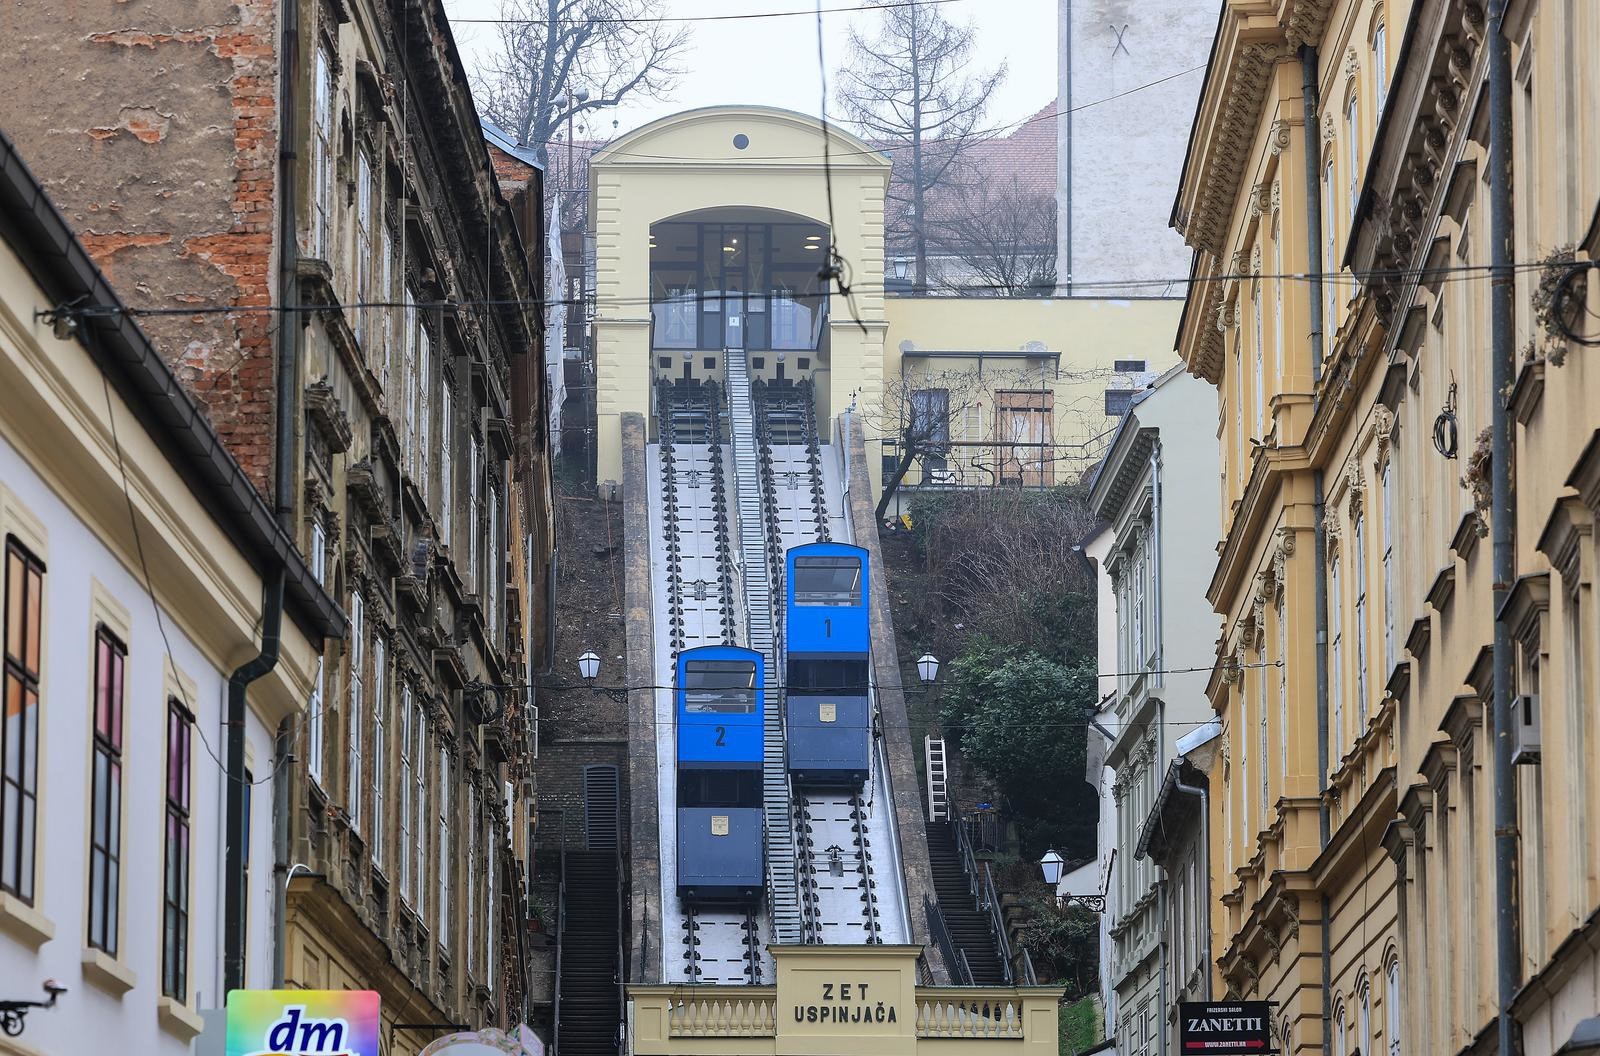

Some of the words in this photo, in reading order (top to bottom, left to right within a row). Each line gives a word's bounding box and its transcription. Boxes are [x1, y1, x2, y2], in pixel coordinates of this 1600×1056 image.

[824, 618, 831, 638] 1
[715, 726, 726, 746] 2
[823, 983, 868, 1000] ZET
[794, 1001, 897, 1023] USPINJAČA
[269, 1009, 343, 1051] dm
[1188, 1017, 1262, 1032] ZANETTI
